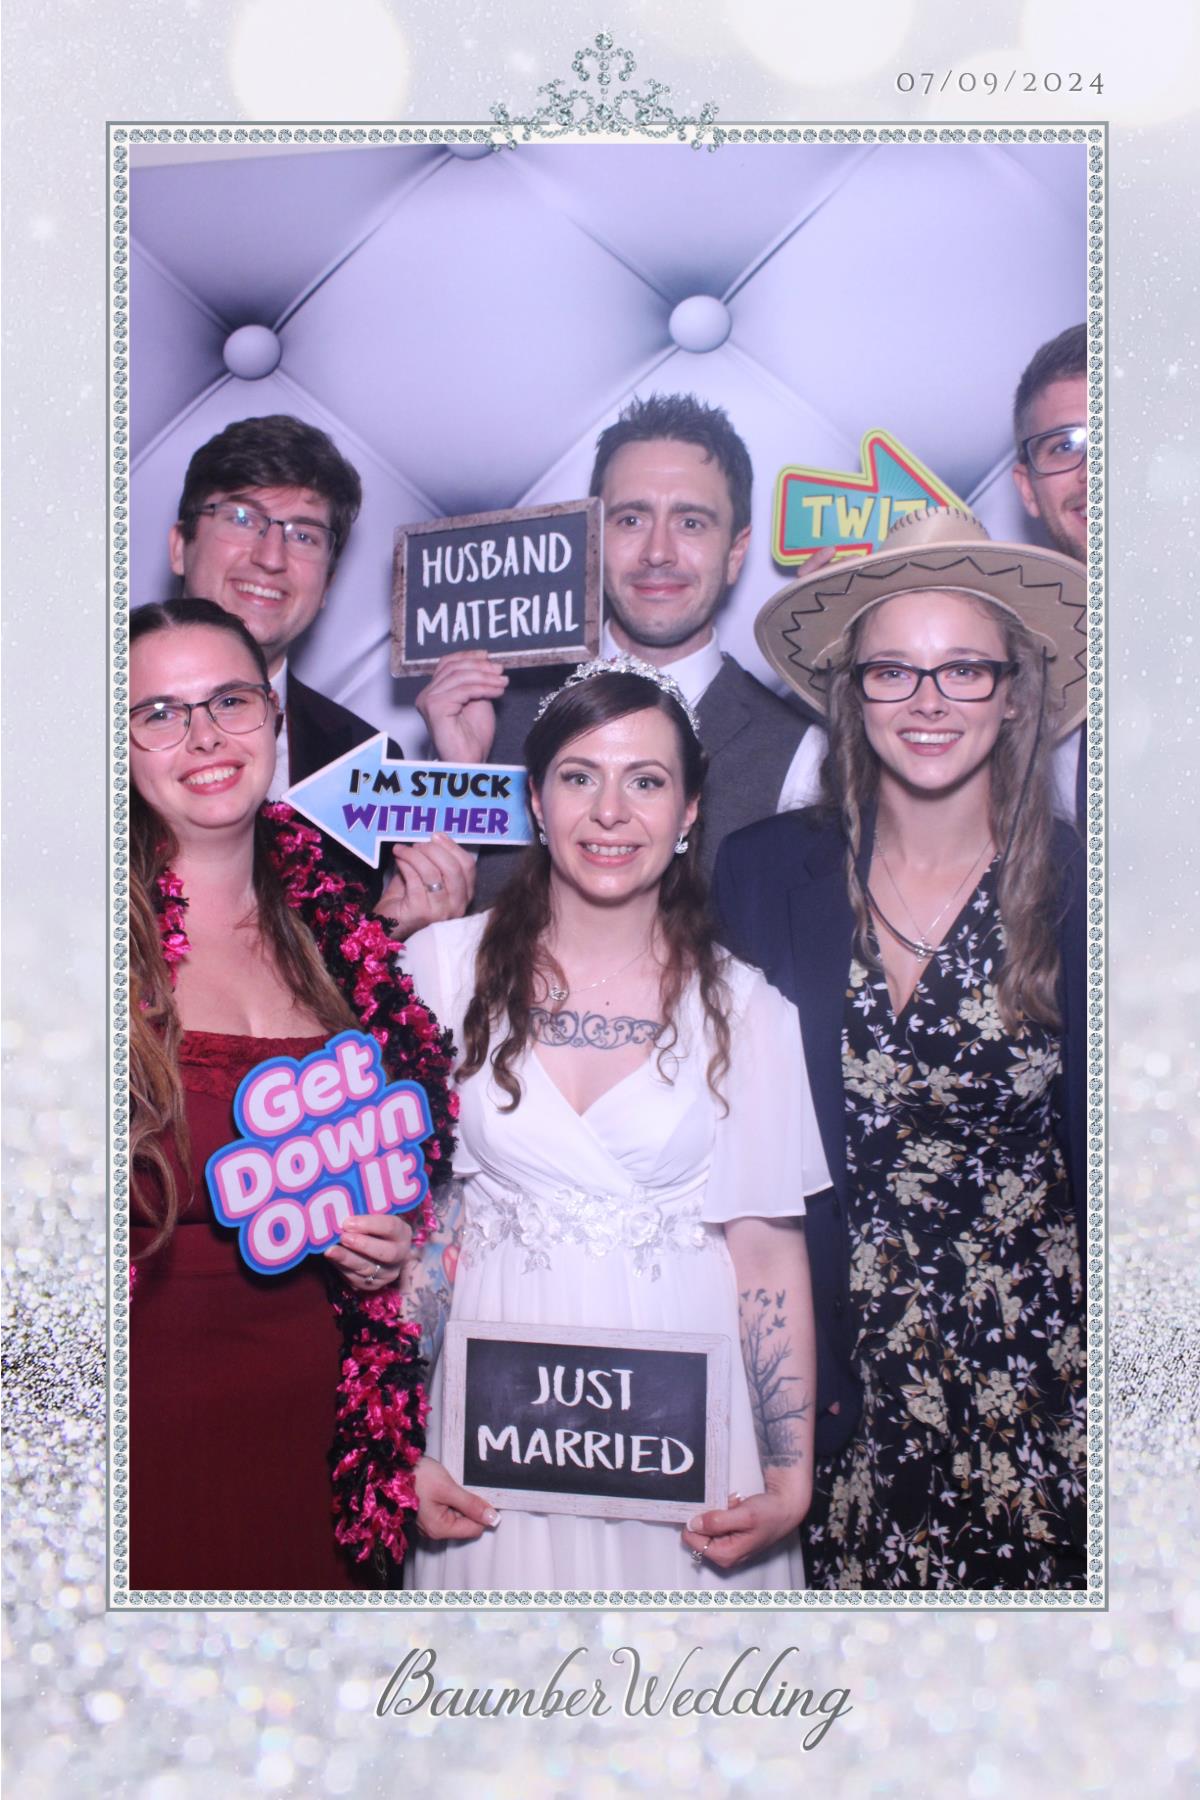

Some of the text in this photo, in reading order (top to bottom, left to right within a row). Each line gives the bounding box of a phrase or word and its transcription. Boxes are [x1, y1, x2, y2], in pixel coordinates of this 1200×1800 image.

[422, 532, 572, 588] HUSBAND
[416, 590, 579, 646] MATERIAL
[349, 768, 512, 799] I'M STUCK
[342, 803, 509, 835] WITH HER
[246, 1042, 376, 1134] Get
[218, 1093, 423, 1216] Down
[251, 1151, 419, 1262] On It
[530, 1365, 634, 1411] JUST
[477, 1425, 695, 1475] MARRIED
